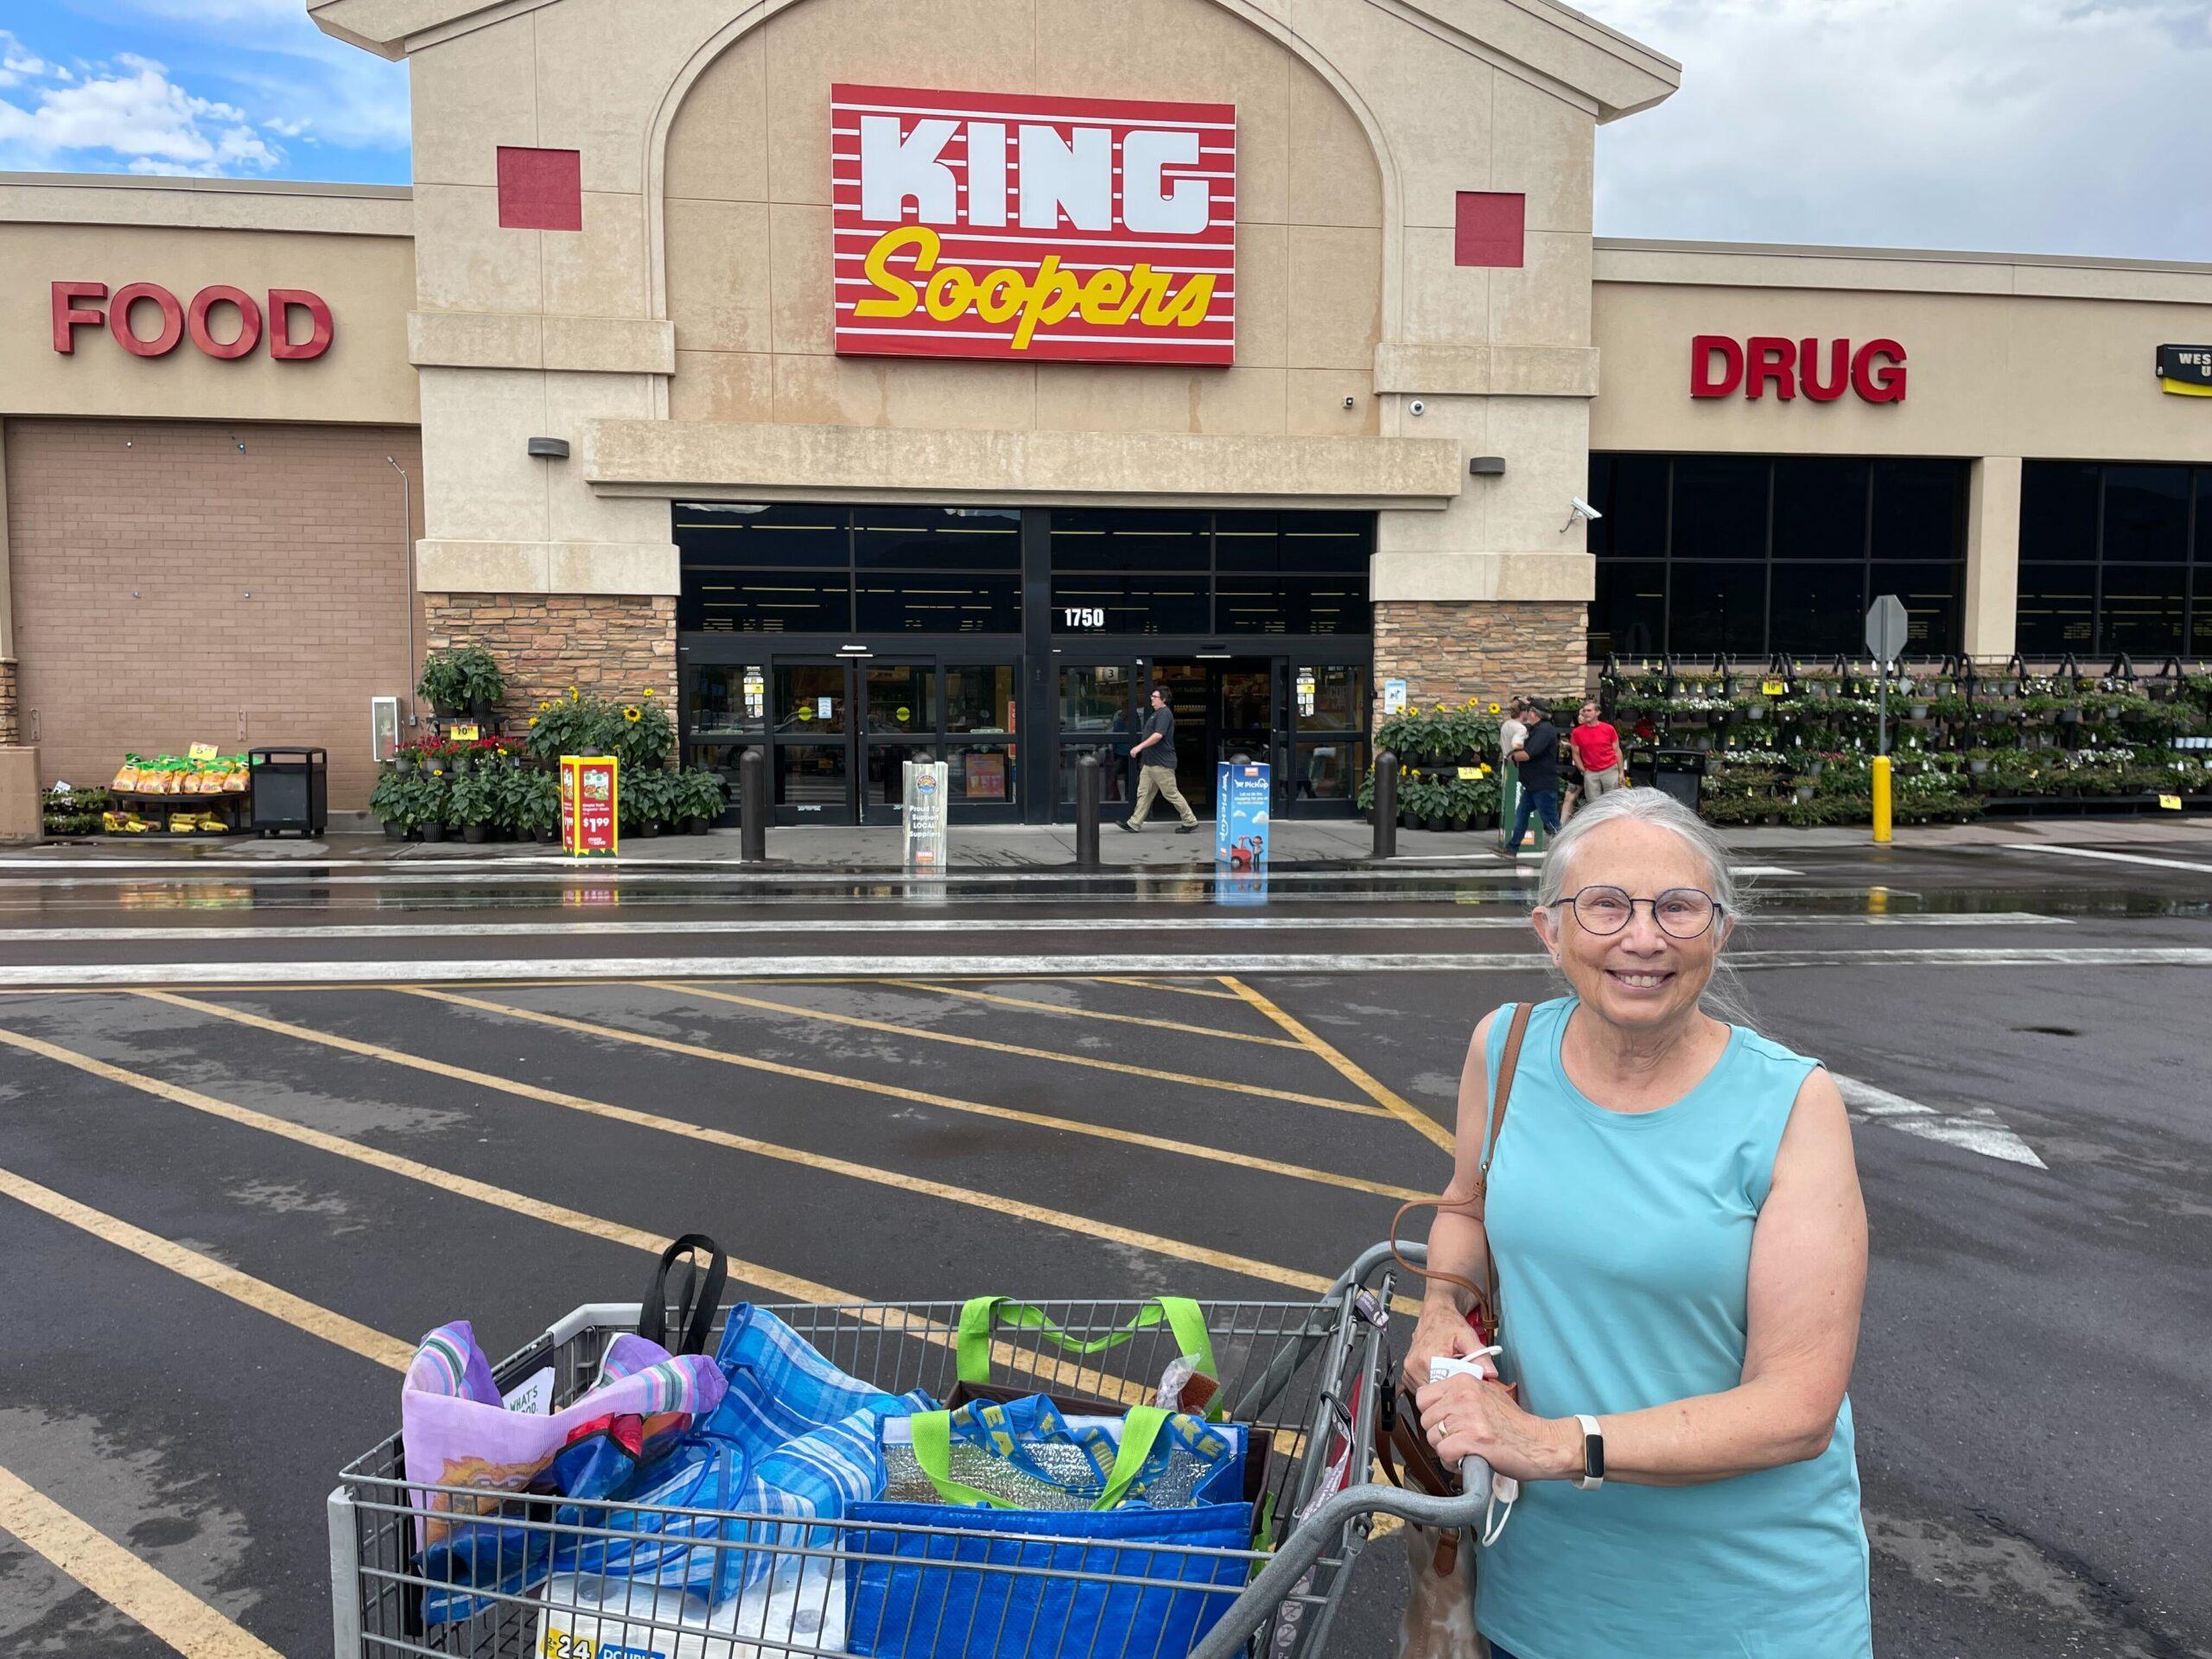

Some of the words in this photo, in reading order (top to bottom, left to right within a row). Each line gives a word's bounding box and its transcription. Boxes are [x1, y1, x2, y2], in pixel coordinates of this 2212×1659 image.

[861, 116, 1210, 234] KING
[52, 282, 334, 360] FOOD
[854, 226, 1217, 350] Soopers
[1691, 335, 1906, 404] DRUG
[1065, 608, 1104, 627] 1750
[510, 1384, 538, 1412] WHAT'S
[556, 1634, 592, 1659] 24
